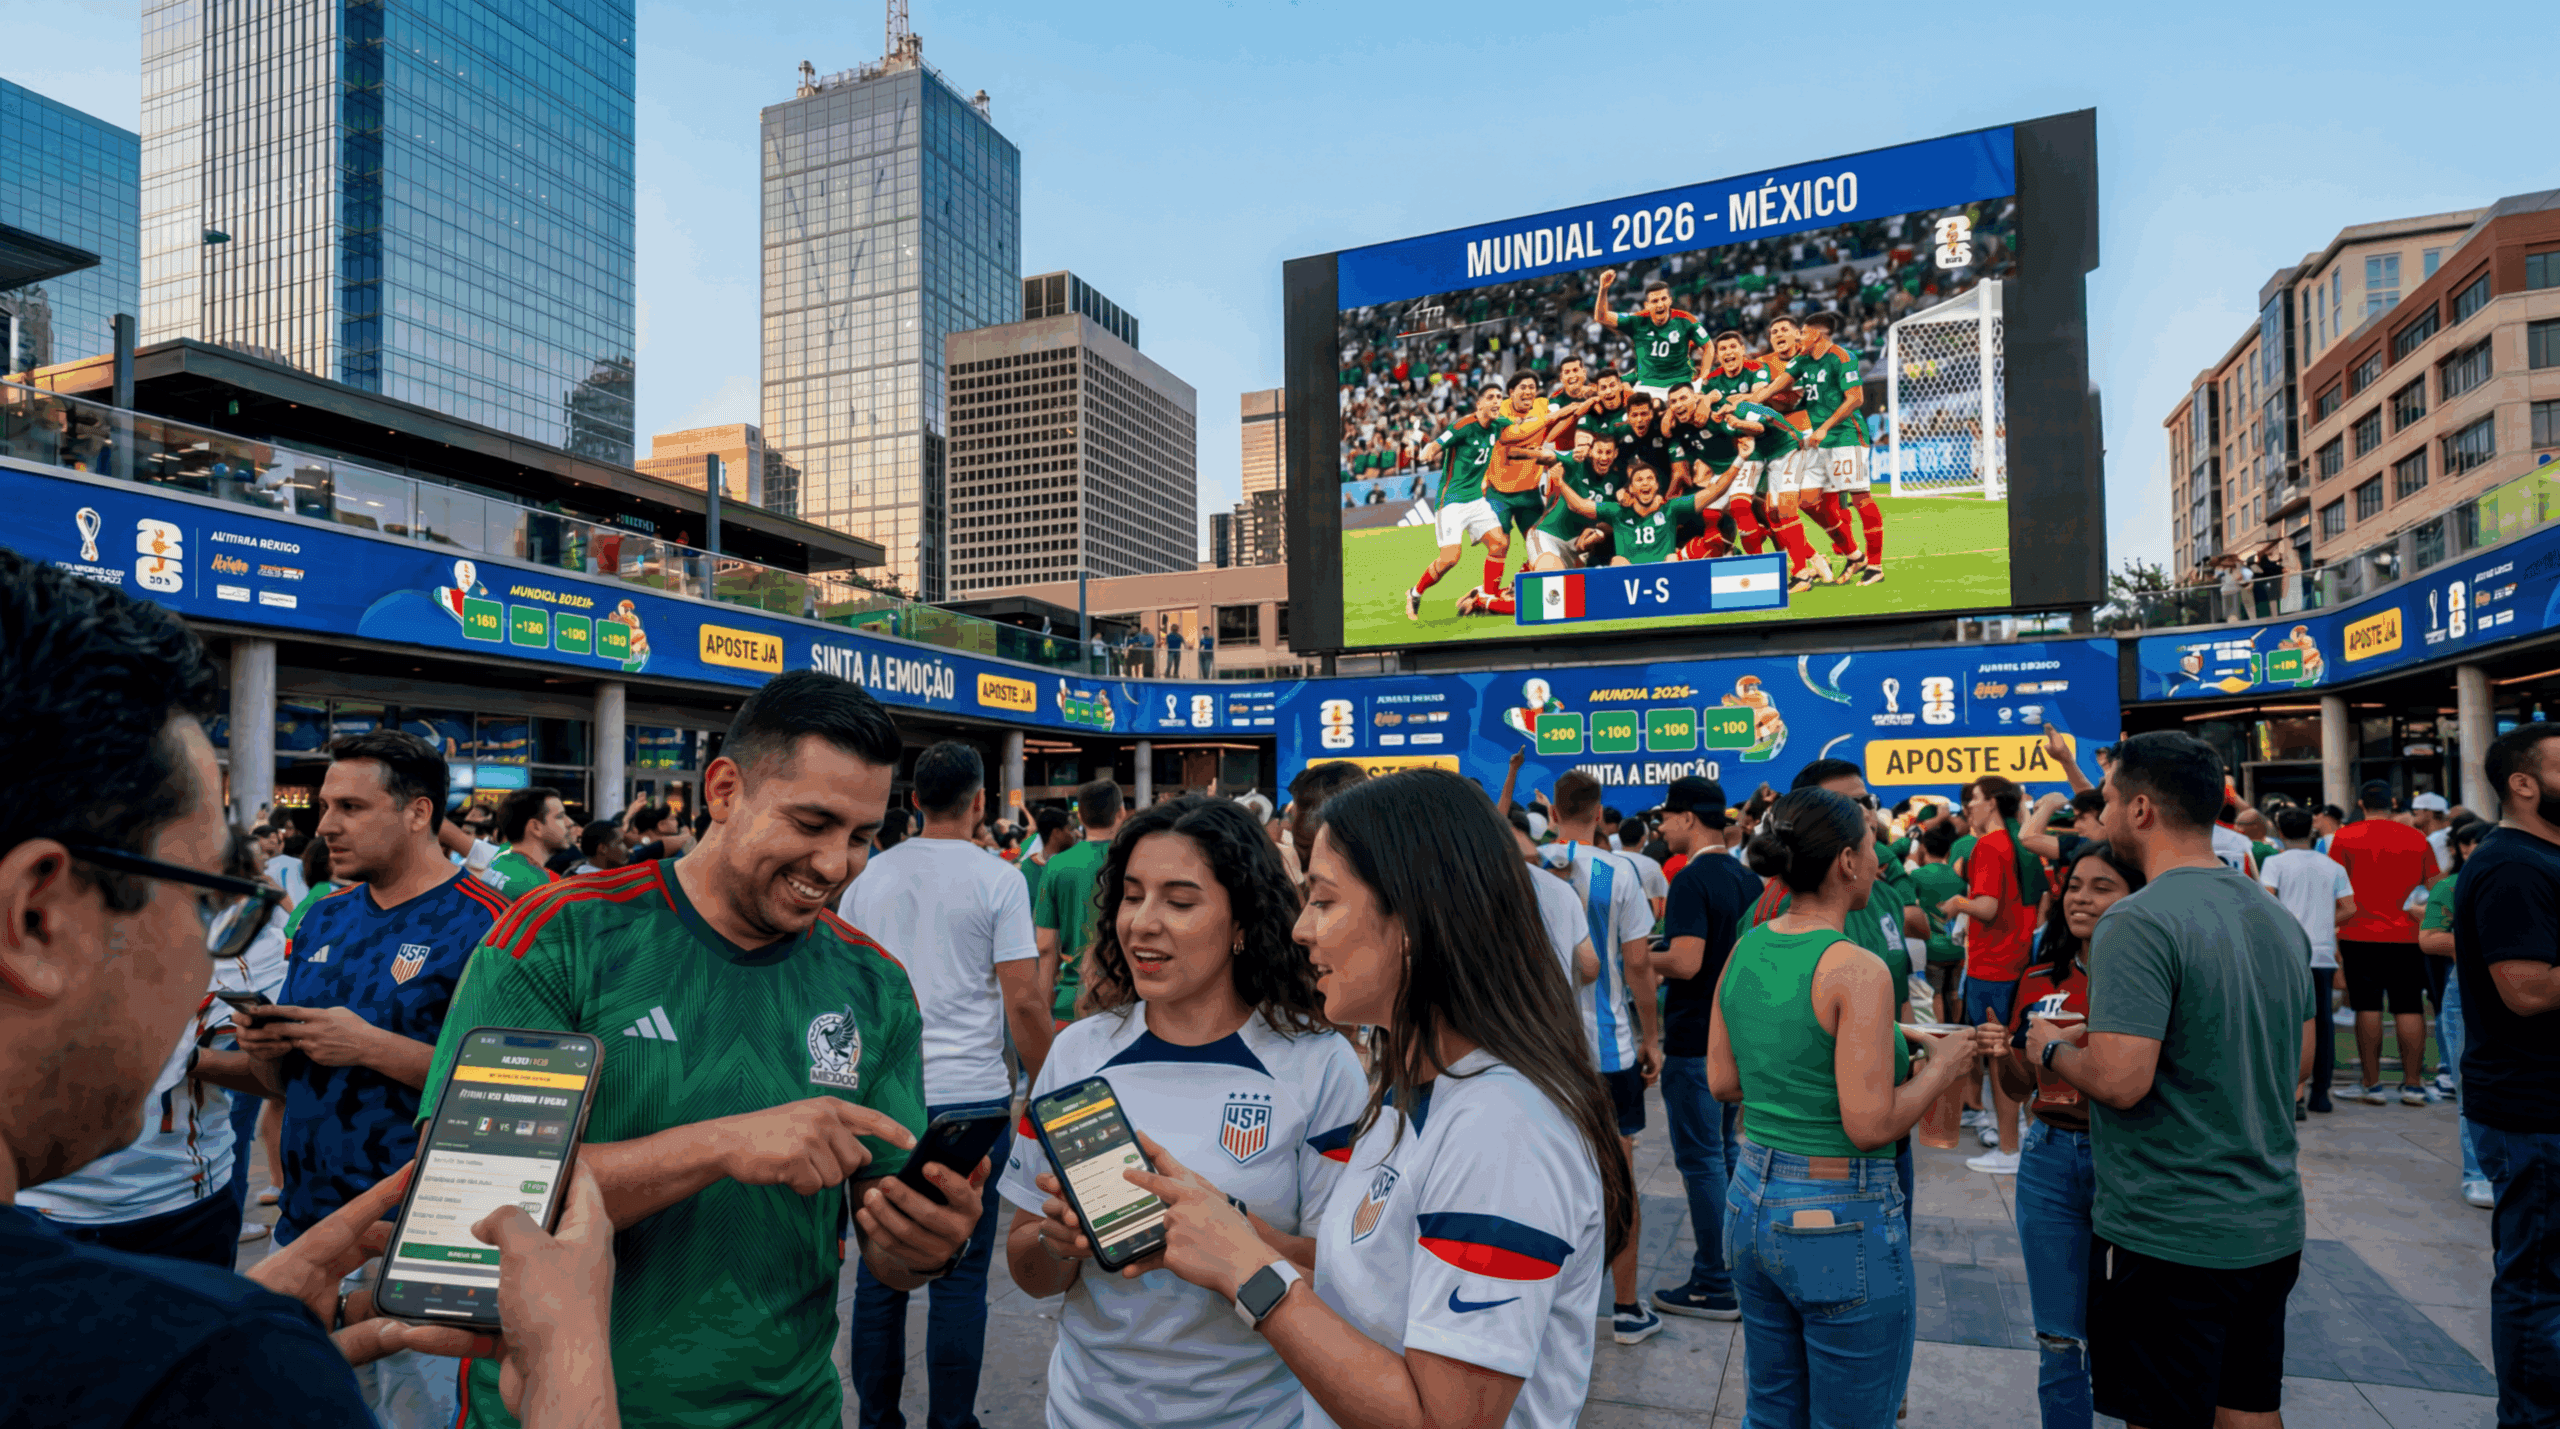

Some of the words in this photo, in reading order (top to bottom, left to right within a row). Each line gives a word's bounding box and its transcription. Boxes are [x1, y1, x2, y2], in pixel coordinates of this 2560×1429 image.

[1467, 221, 1602, 278] MUNDIAL
[1612, 202, 1694, 253] 2026
[1729, 172, 1858, 232] MÉXICO
[1650, 340, 1670, 357] 10
[1635, 526, 1655, 544] 18
[1624, 577, 1669, 605] V-S
[706, 634, 758, 661] APOSTE
[811, 644, 865, 686] SINTA
[869, 655, 882, 689] A
[885, 657, 955, 703] EMOÇÃO
[1886, 746, 2000, 775] APOSTE
[2010, 739, 2049, 771] JÁ
[1628, 763, 1640, 785] A
[400, 945, 429, 963] USA
[1227, 1107, 1267, 1129] USA
